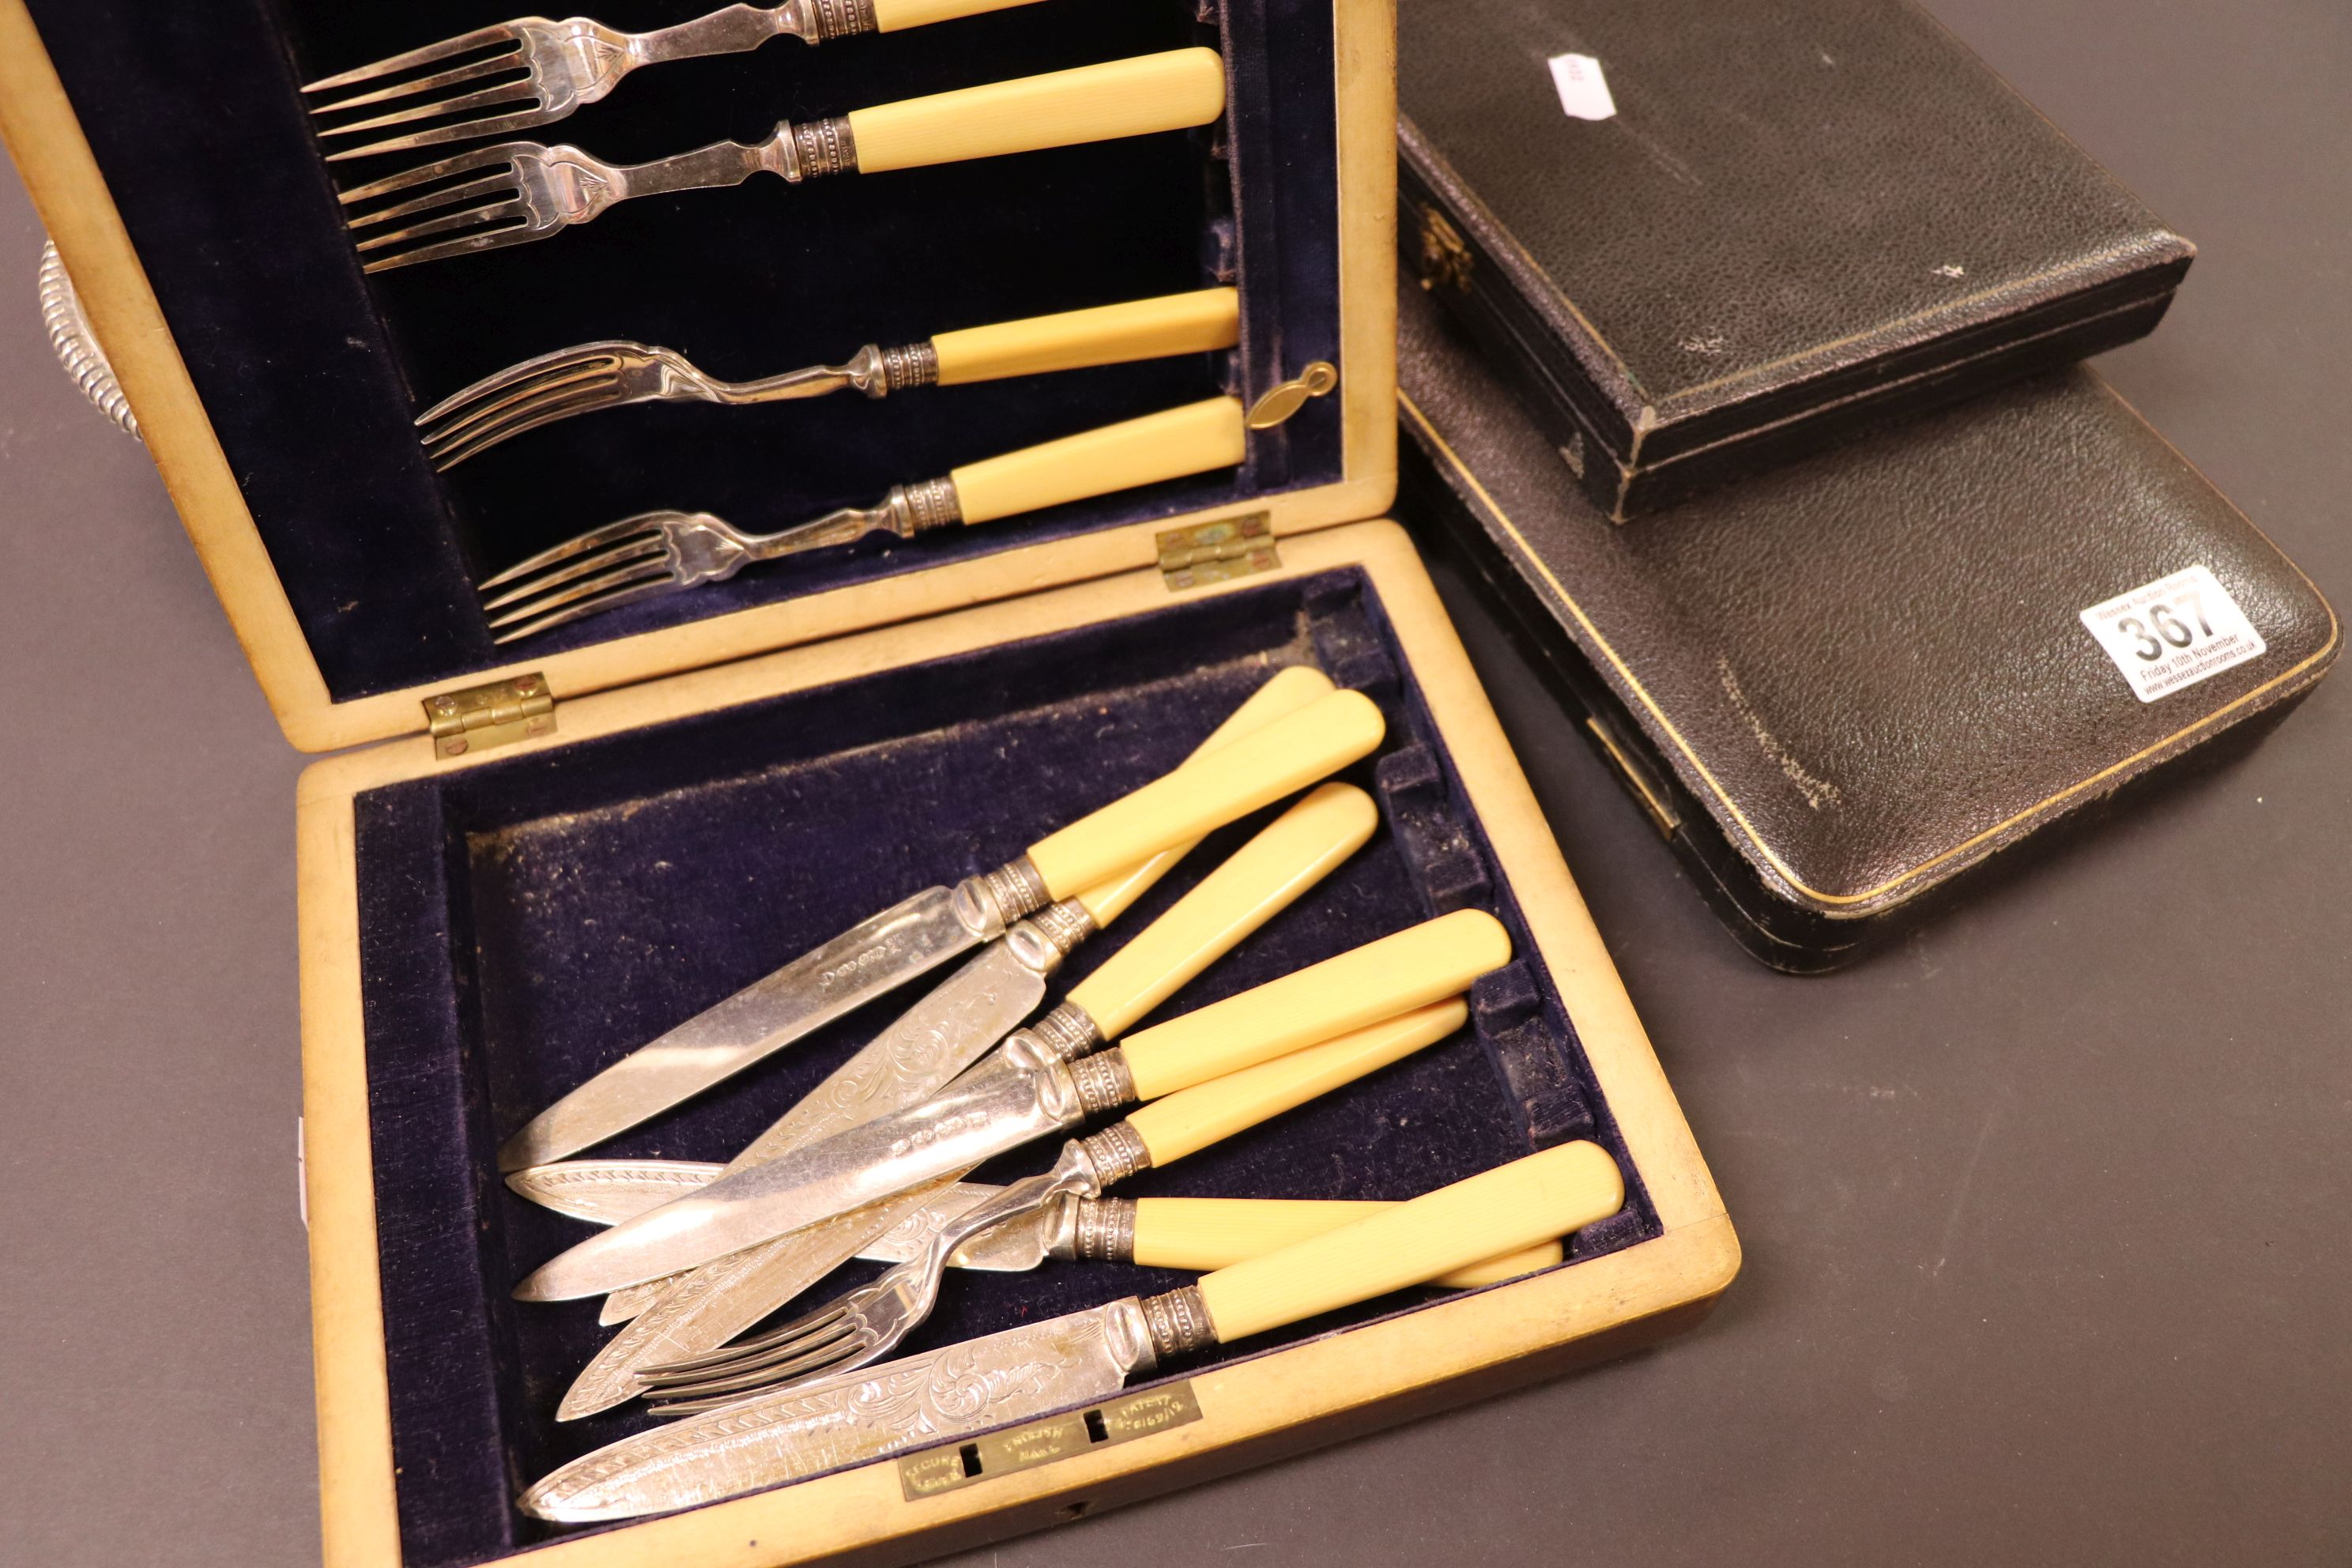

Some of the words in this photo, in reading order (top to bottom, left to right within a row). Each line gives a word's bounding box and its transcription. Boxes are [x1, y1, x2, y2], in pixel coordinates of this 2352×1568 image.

[2097, 603, 2131, 620] Wessex
[2132, 590, 2166, 606] Auction
[2117, 591, 2214, 662] 367
[2139, 662, 2173, 682] Friday
[2171, 653, 2192, 669] 10th
[2192, 634, 2240, 661] November
[2143, 640, 2256, 695] www.wessexauctionrooms.co.uk
